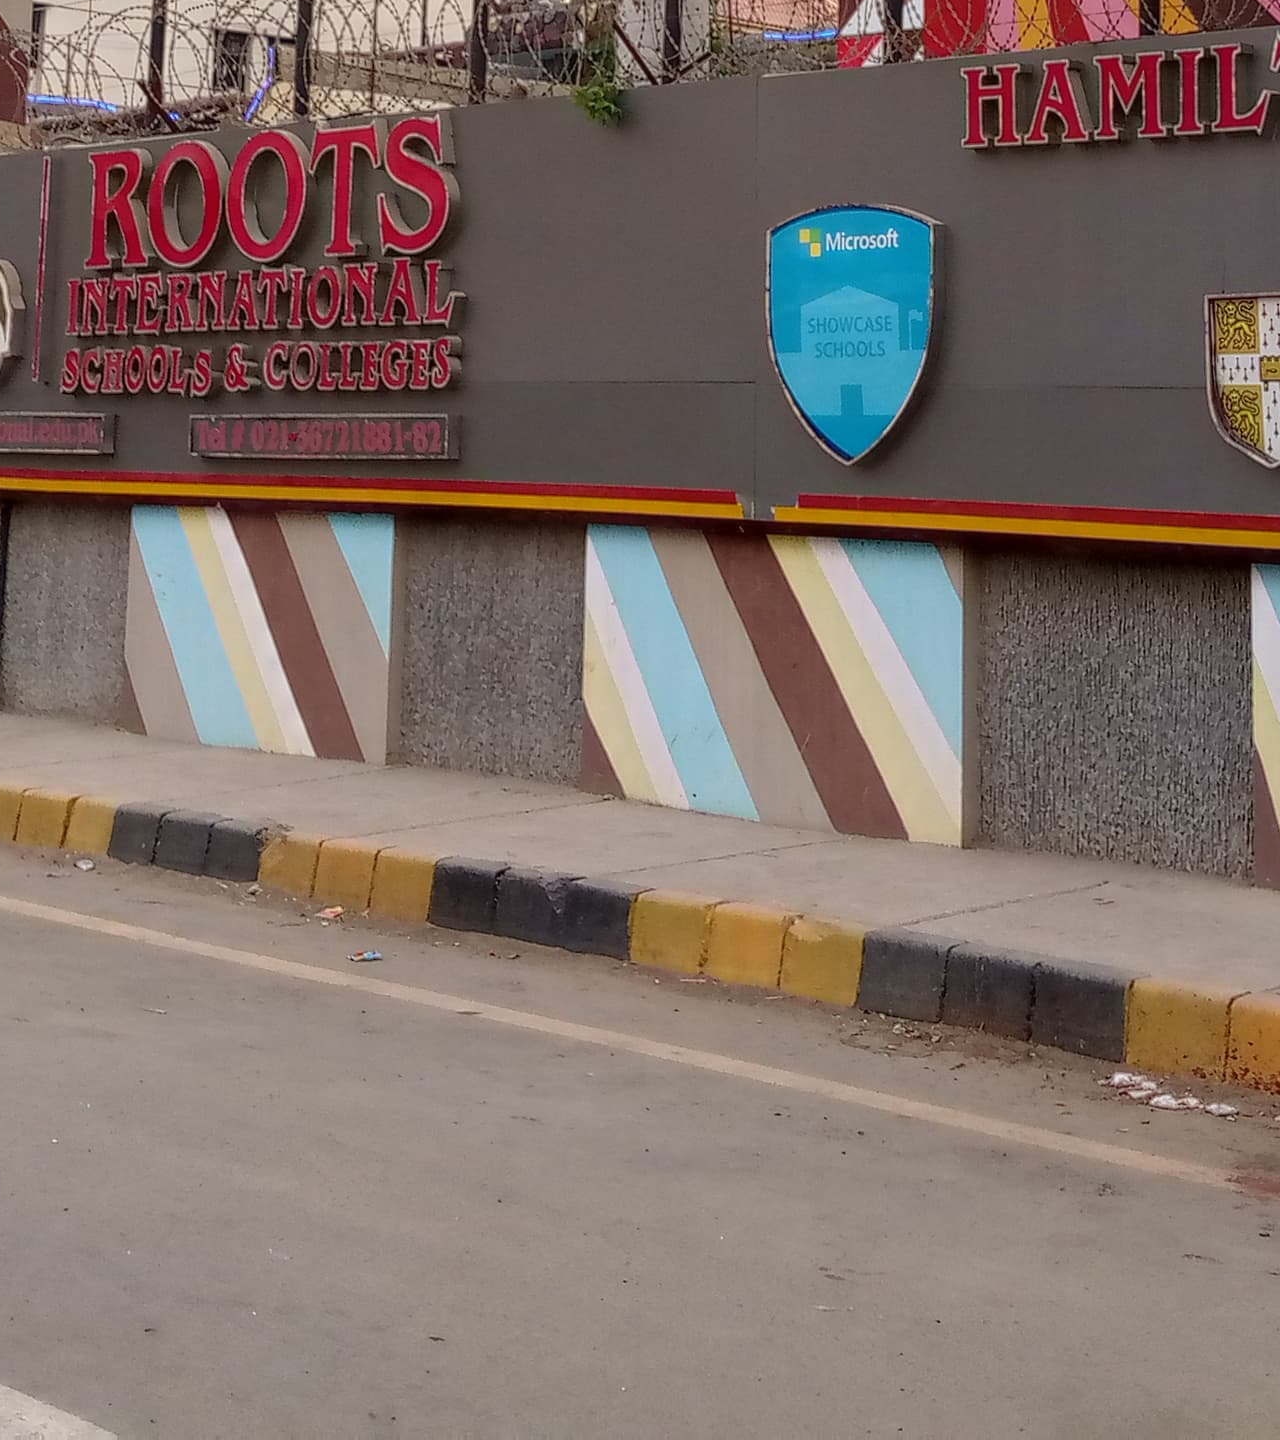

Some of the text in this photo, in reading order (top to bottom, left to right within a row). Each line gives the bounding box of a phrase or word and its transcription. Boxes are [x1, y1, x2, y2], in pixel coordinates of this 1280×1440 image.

[84, 114, 458, 269] ROOTS
[825, 227, 900, 253] Microsoft
[66, 260, 464, 336] INTERNATIONAL
[806, 314, 894, 336] SHOWCASE
[61, 336, 458, 398] SCHOOLS & COLLEGES
[814, 340, 887, 360] SCHOOLS
